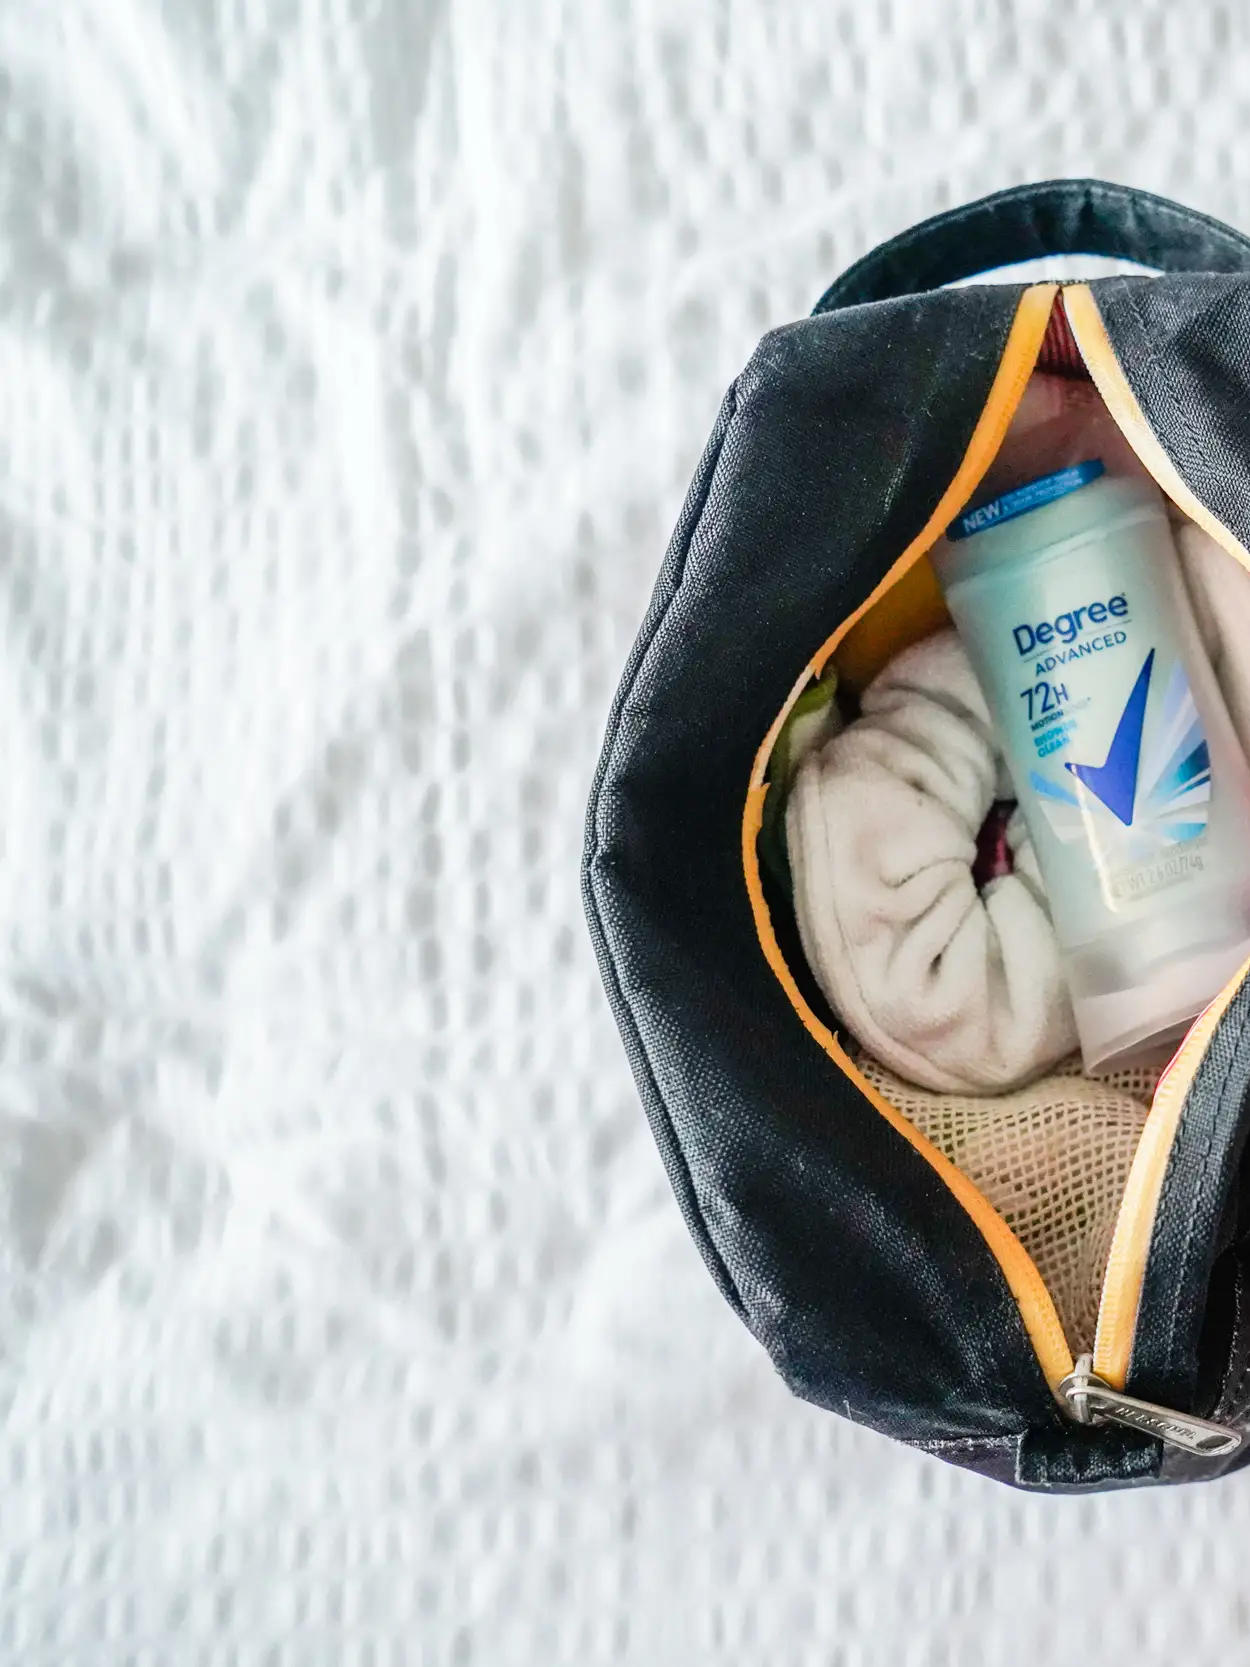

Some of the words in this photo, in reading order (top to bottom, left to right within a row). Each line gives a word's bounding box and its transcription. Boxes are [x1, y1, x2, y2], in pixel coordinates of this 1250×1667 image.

[963, 500, 1000, 532] NEW
[1013, 596, 1128, 656] Degree
[1036, 631, 1127, 677] ADVANCED
[1020, 681, 1069, 720] 72H
